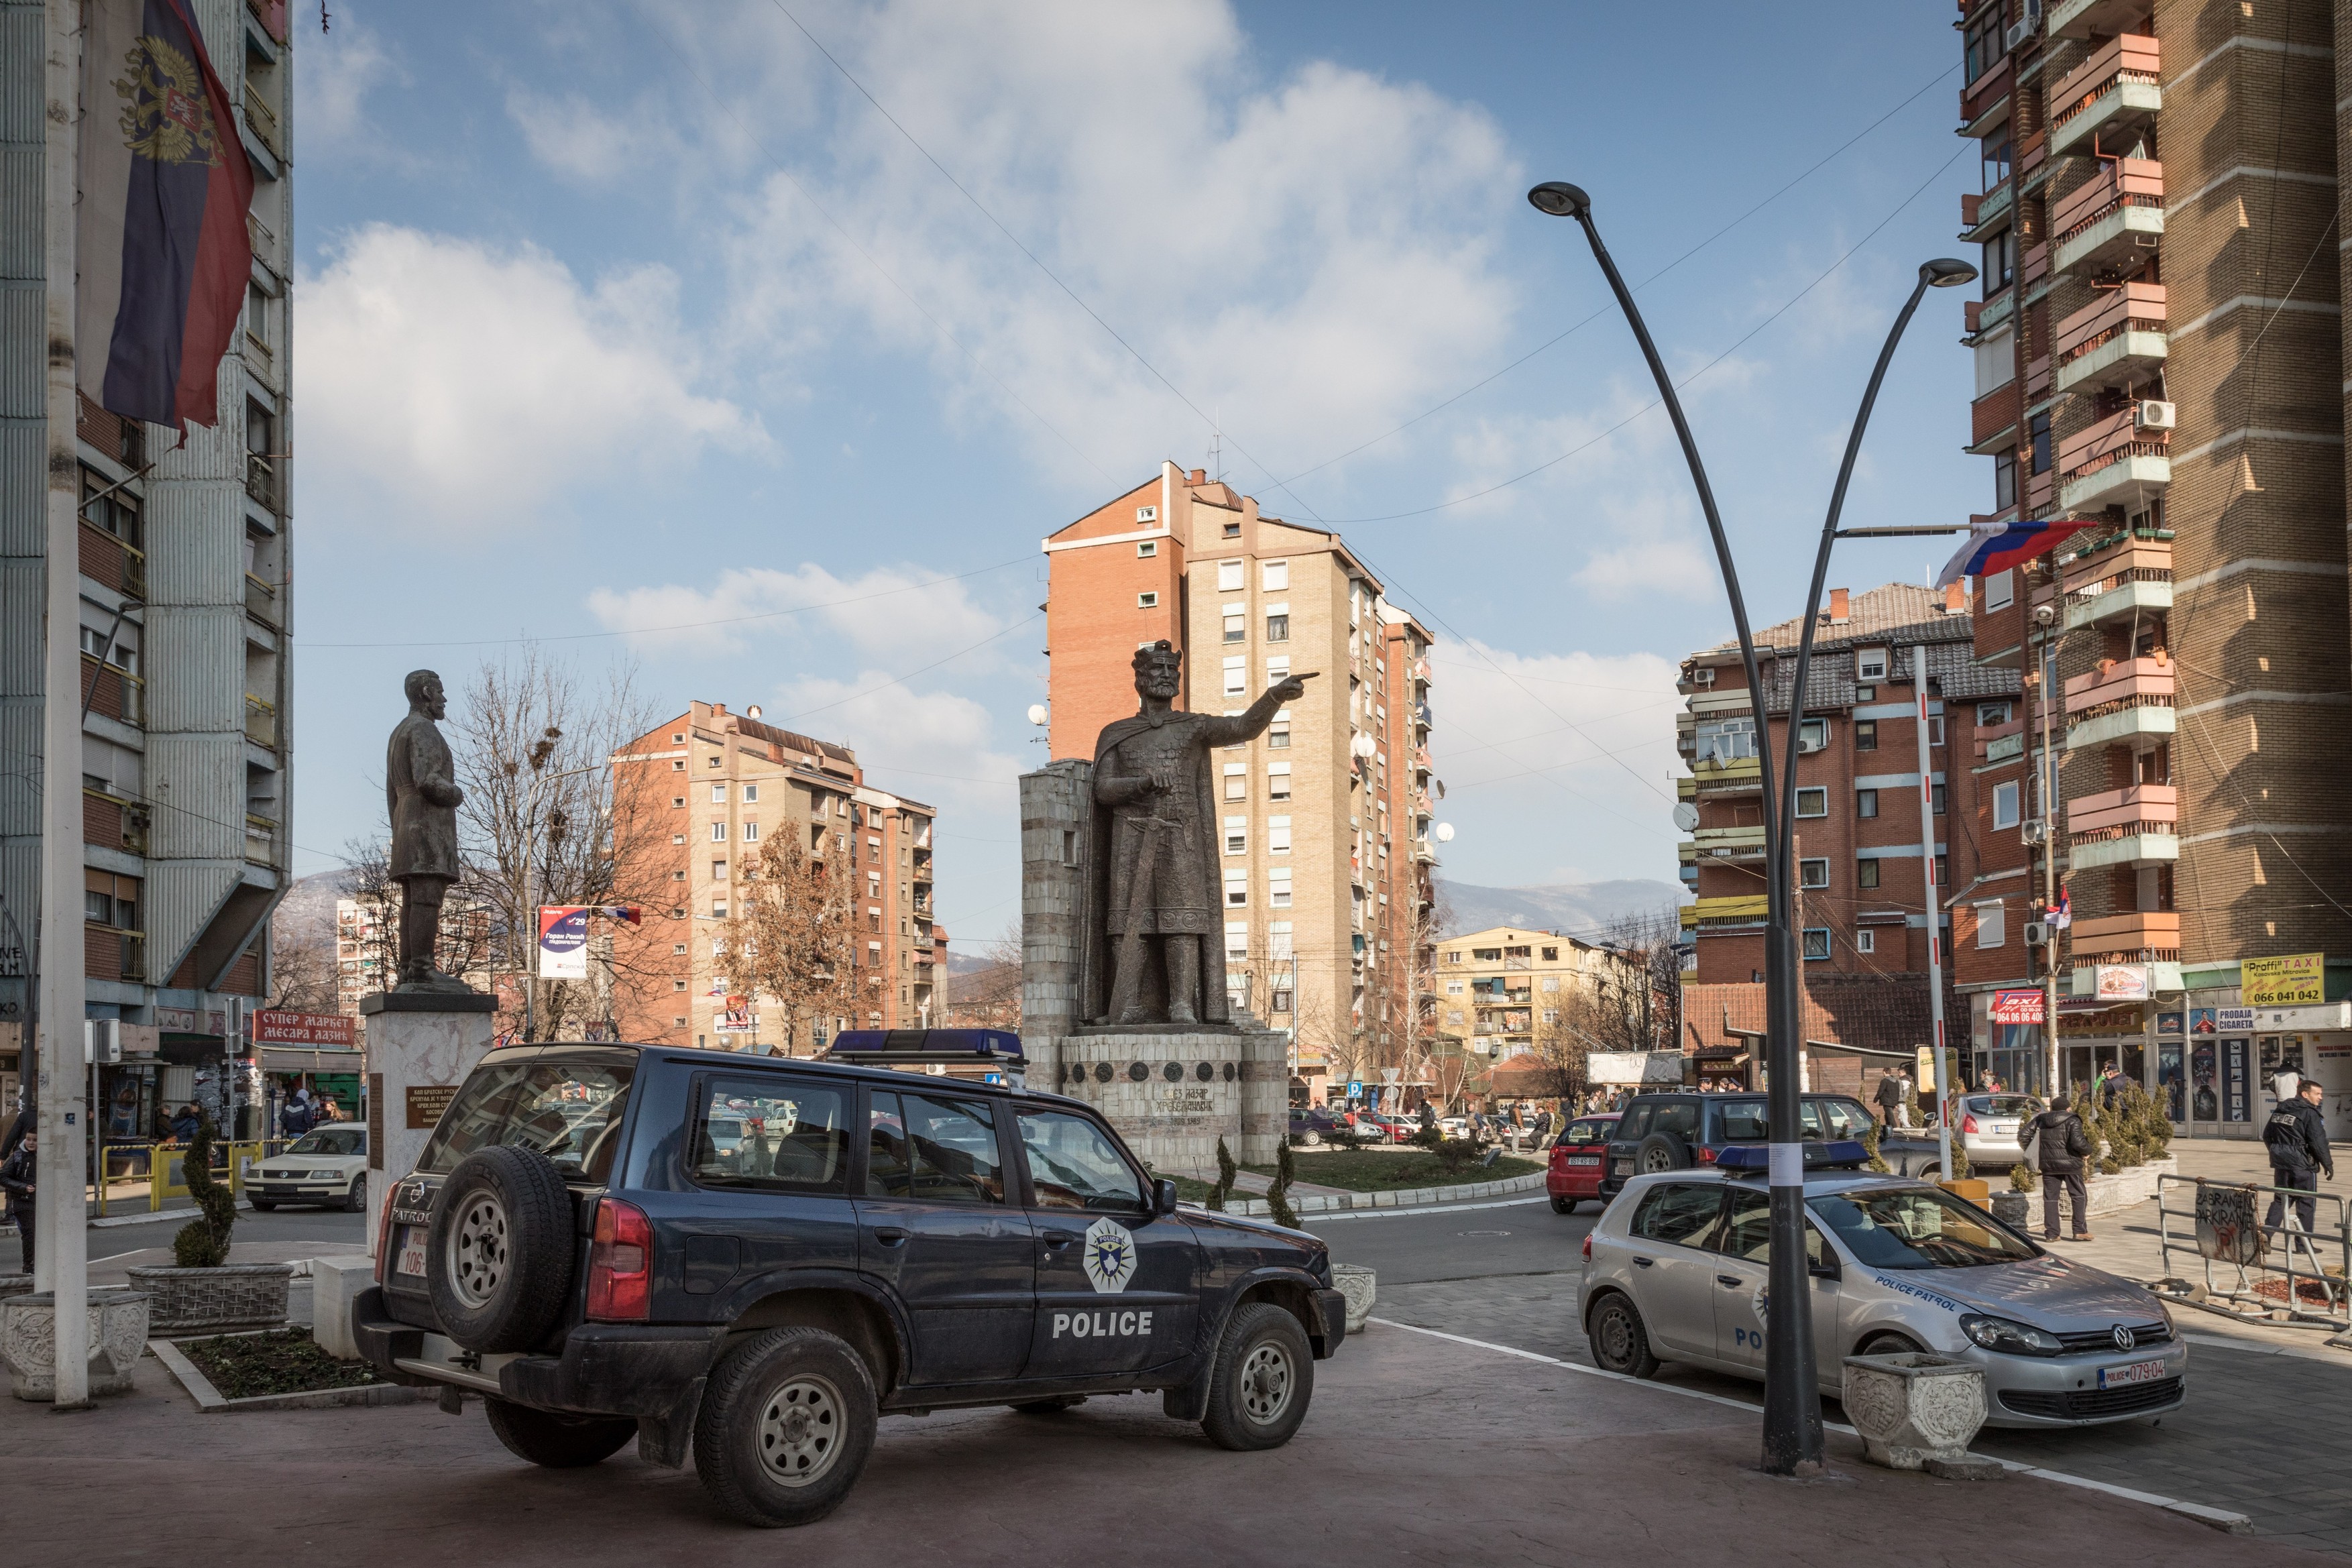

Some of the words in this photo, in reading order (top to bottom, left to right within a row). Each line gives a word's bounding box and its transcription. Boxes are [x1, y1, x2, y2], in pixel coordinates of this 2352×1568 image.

[2283, 957, 2320, 969] TAXI
[2267, 977, 2288, 992] JEFTINO
[2254, 993, 2274, 1003] 066
[2277, 991, 2295, 1001] 041
[2298, 990, 2318, 1000] 042
[263, 1013, 299, 1025] СУПЕР
[305, 1015, 348, 1029] МАРКЕТ
[1997, 1012, 2009, 1022] 064
[2011, 1012, 2020, 1022] 06
[2021, 1012, 2030, 1022] 06
[2031, 1012, 2044, 1022] 406
[2220, 1010, 2252, 1019] PRODAJA
[2219, 1020, 2253, 1029] CIGARETA
[264, 1027, 310, 1039] МЕСАРА
[315, 1029, 348, 1042] ЛАЗИЋ
[1186, 1088, 1209, 1100] ЛАЗАР
[1351, 1083, 1359, 1095] P
[390, 1207, 433, 1223] PATROL
[412, 1233, 428, 1246] POLIC
[1875, 1276, 1915, 1295] POLICE
[1913, 1290, 1956, 1312] PATROL
[1052, 1311, 1153, 1339] POLICE
[2106, 1370, 2125, 1383] POLICE
